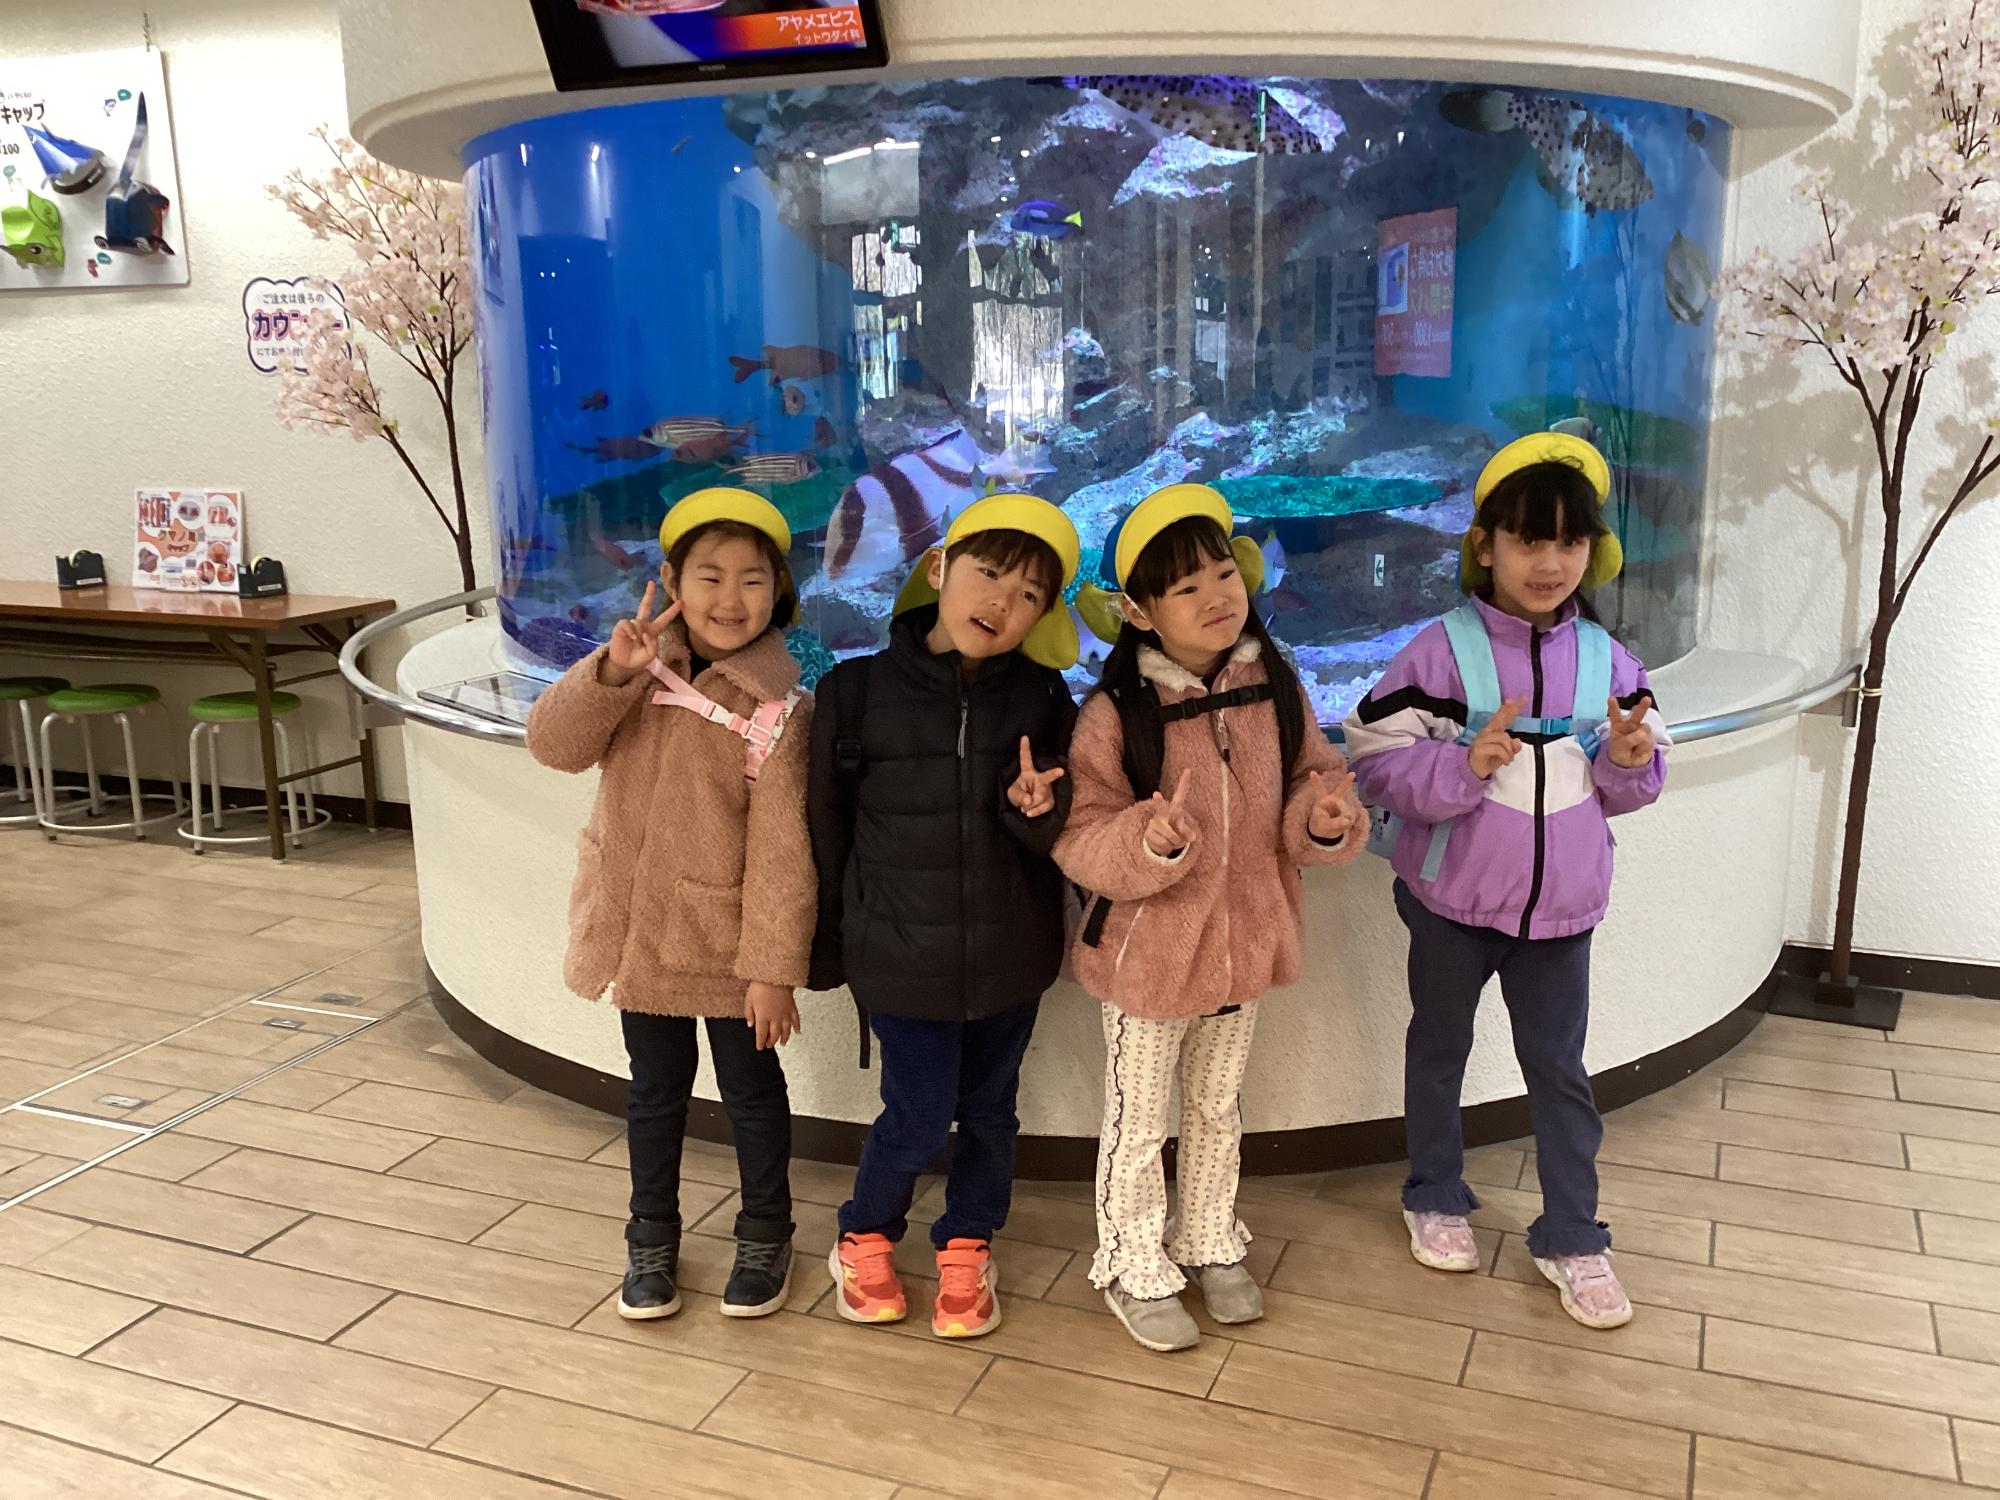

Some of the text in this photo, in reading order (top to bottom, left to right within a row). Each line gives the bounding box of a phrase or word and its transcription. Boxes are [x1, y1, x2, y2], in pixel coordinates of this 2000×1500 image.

[776, 10, 858, 31] アヤメエビス
[0, 99, 46, 125] キャップ
[0, 143, 20, 155] 100
